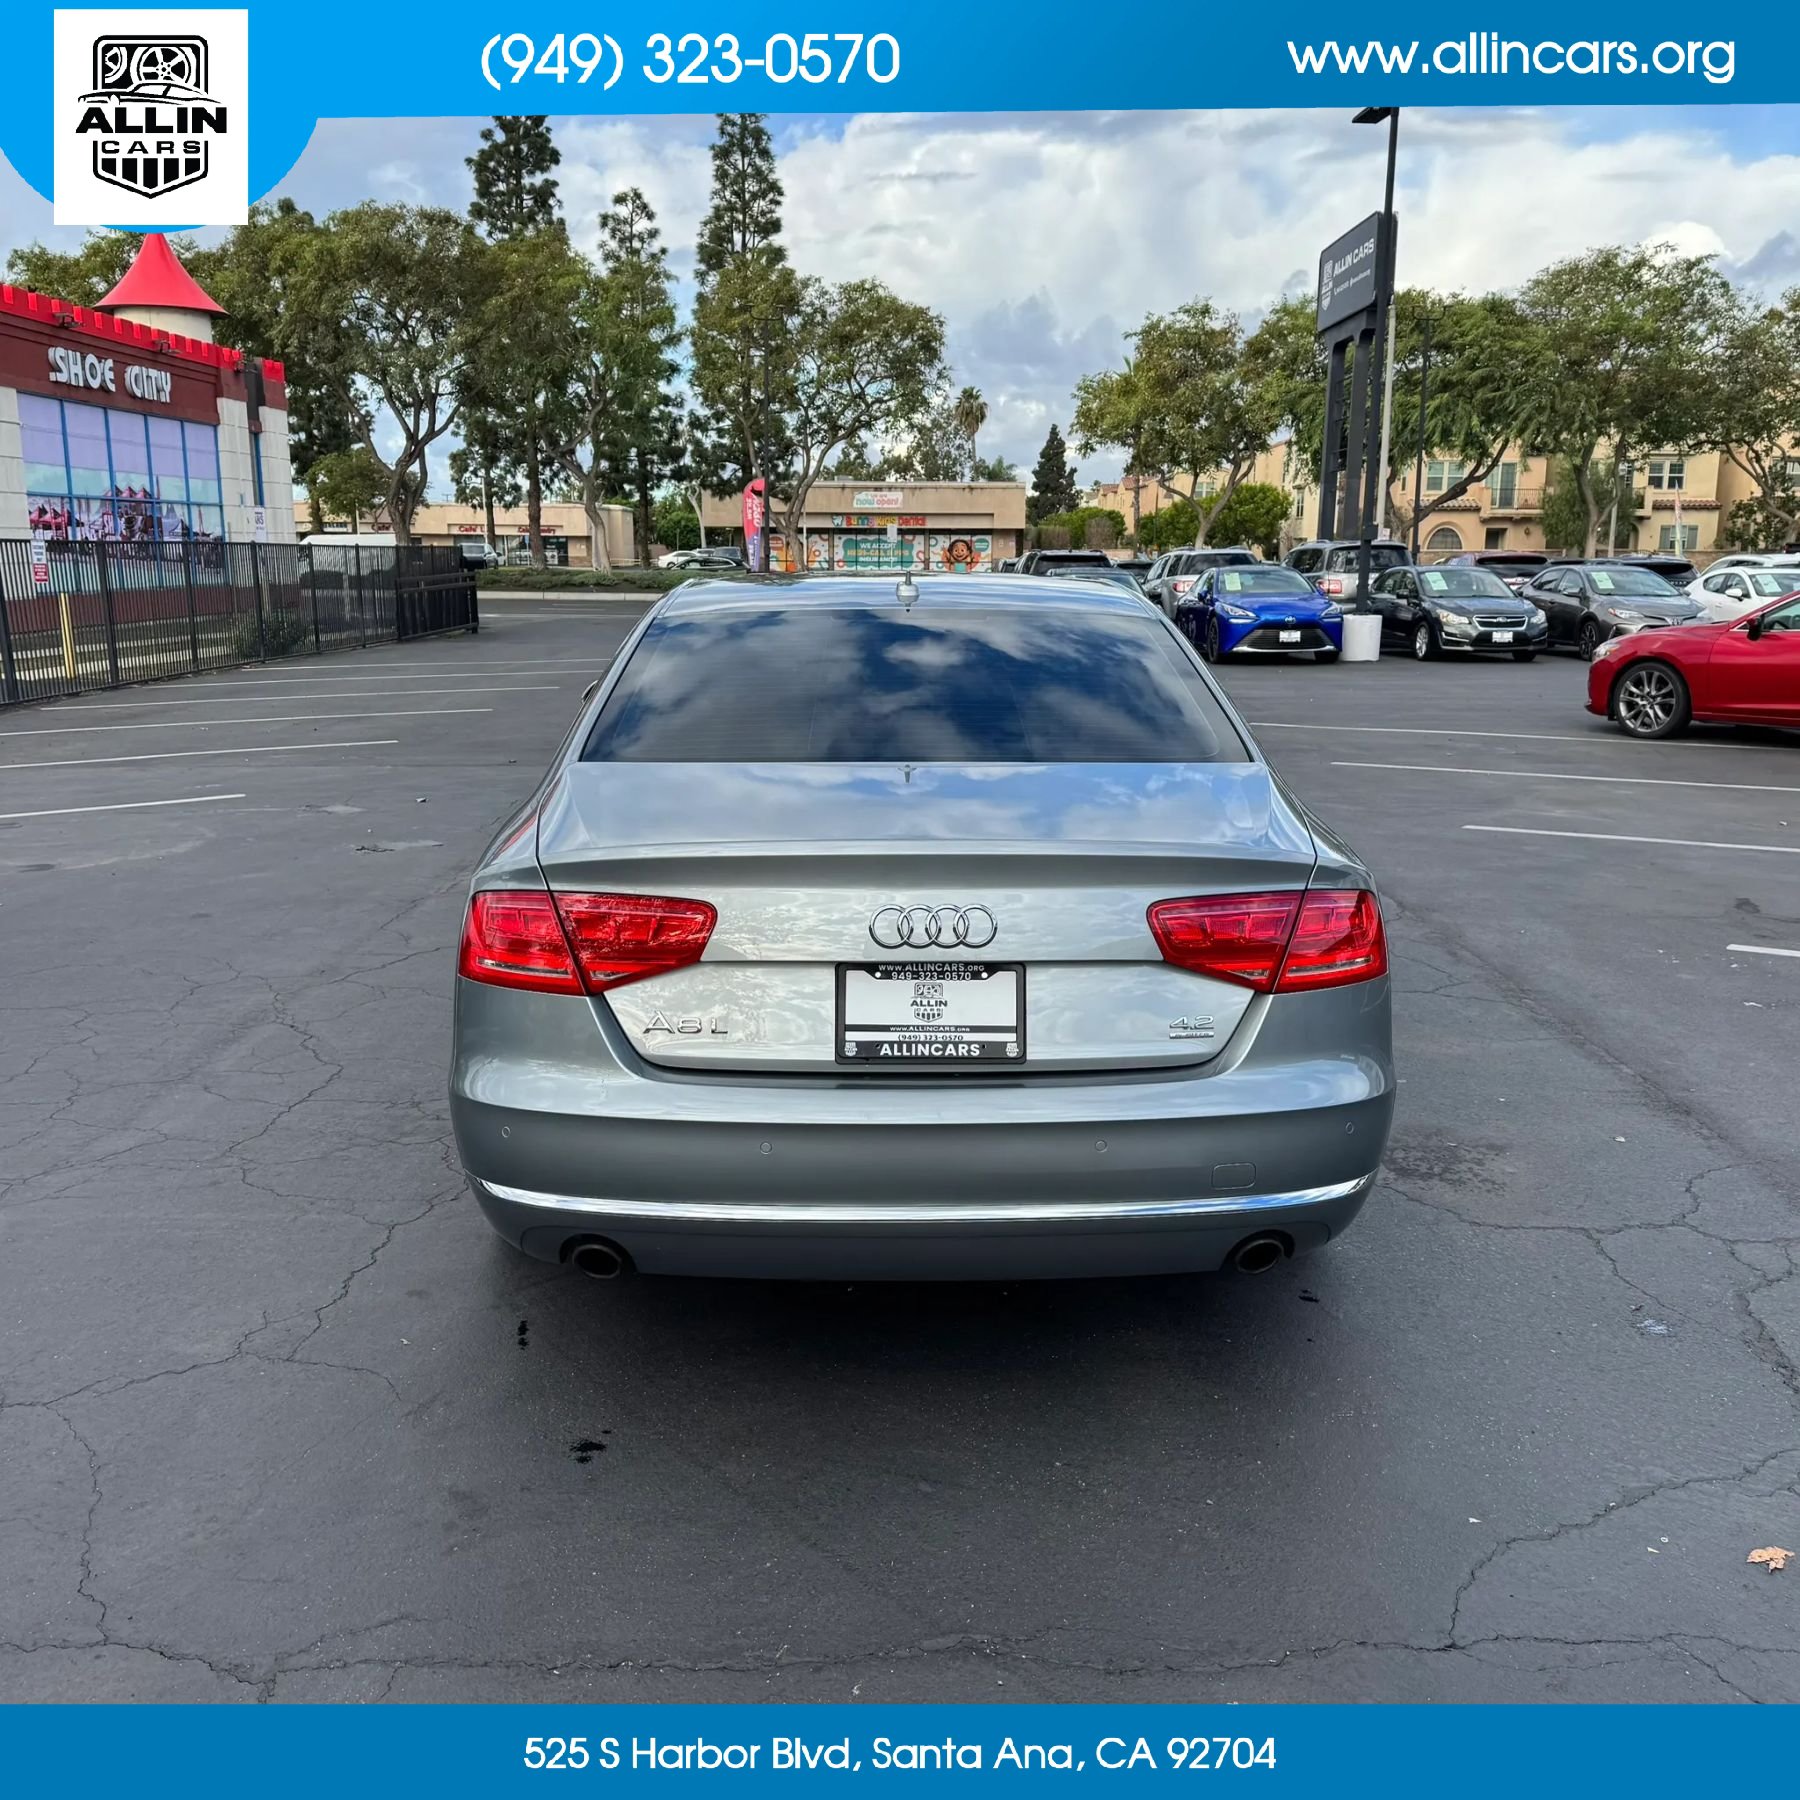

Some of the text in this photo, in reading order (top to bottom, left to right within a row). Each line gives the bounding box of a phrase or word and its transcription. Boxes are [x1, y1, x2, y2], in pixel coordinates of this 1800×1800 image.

[1333, 238, 1374, 277] ALLIN CARS
[48, 347, 172, 403] SHOE CITY
[891, 972, 972, 981] 949-323-0570
[910, 999, 948, 1007] ALLIN
[1169, 1014, 1215, 1030] 4.2
[879, 1043, 981, 1056] ALLINCARS
